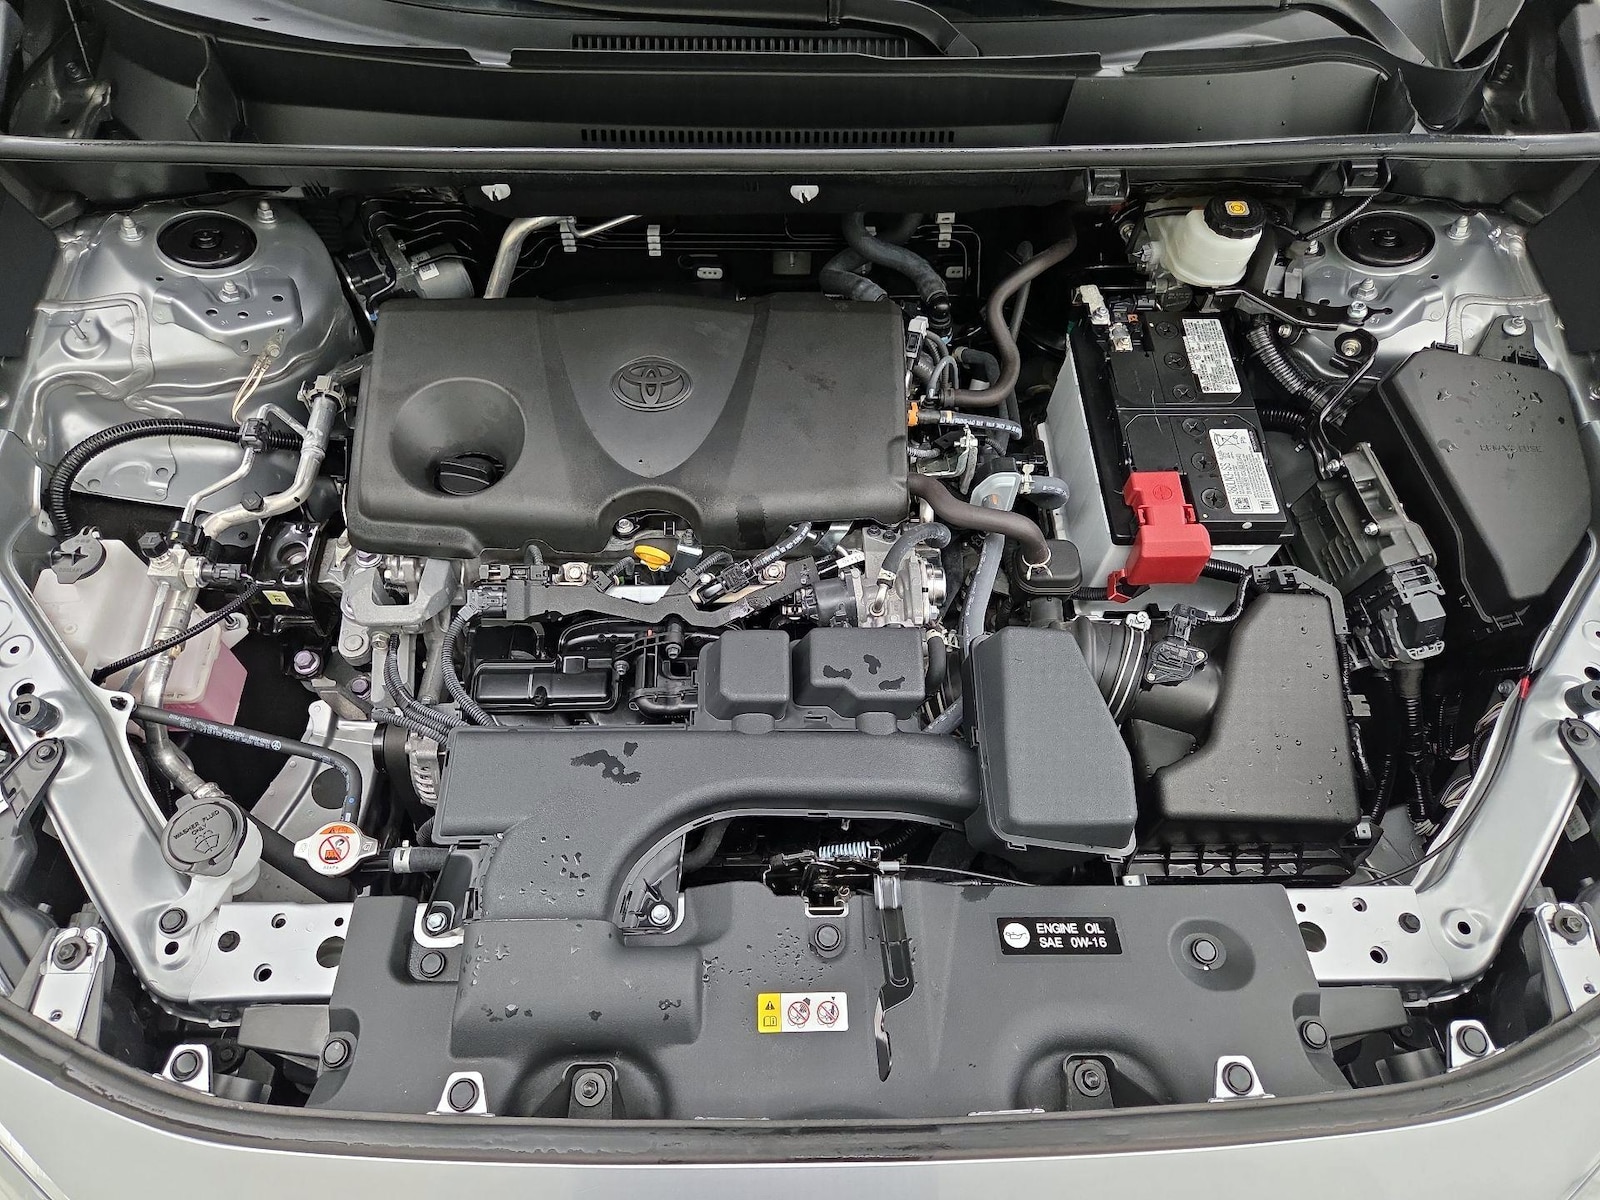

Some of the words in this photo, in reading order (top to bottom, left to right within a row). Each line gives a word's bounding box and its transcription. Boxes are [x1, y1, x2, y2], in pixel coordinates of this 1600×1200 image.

[1518, 445, 1544, 453] FUSE
[173, 821, 200, 840] WASHER
[202, 810, 220, 822] FLUID
[191, 823, 207, 836] ONLY
[1036, 922, 1079, 934] ENGINE
[1085, 922, 1105, 934] OIL
[1039, 937, 1064, 948] SAE
[1070, 937, 1107, 948] 0W-16
